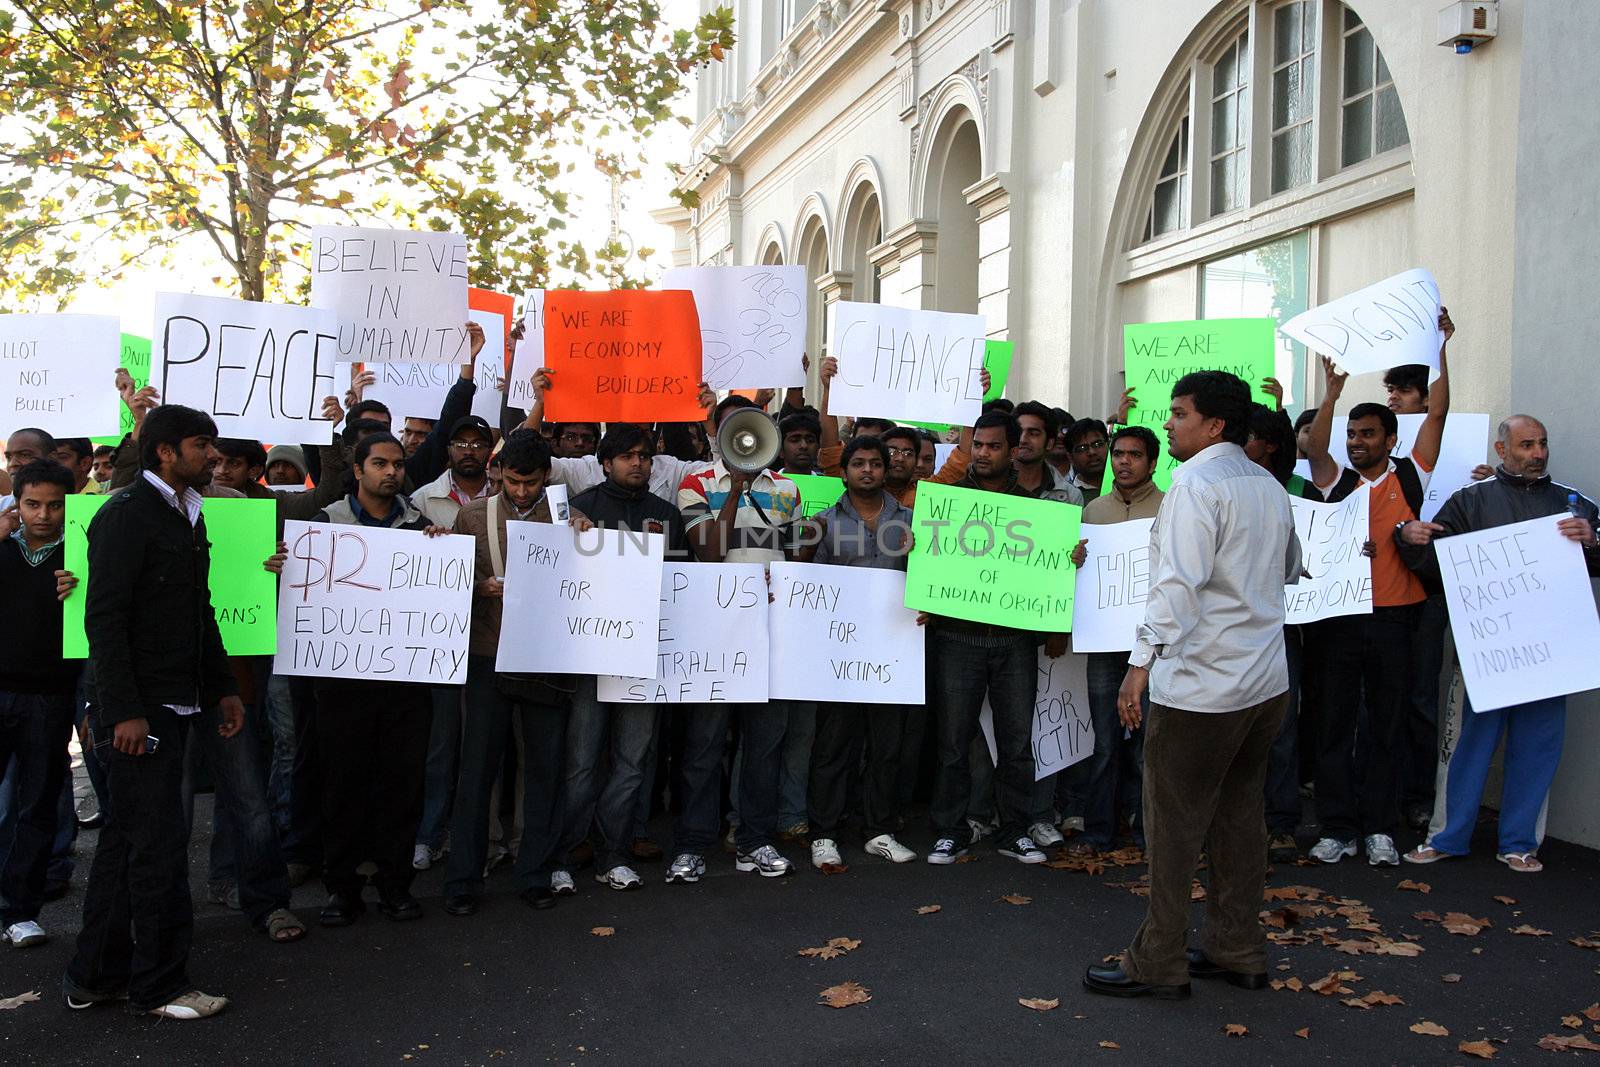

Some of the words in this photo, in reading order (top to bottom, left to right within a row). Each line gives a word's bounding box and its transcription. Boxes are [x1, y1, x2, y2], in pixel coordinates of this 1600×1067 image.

[318, 237, 468, 279] BELIEVE
[366, 285, 401, 320] IN
[600, 310, 632, 327] ARE
[1303, 280, 1438, 356] DIGNIT
[3, 340, 39, 359] LLOT
[338, 323, 470, 362] UMANITY
[569, 341, 663, 360] ECONOMY
[1131, 336, 1168, 358] WE
[1174, 334, 1220, 356] ARE
[20, 369, 49, 387] NOT
[161, 315, 338, 421] PEACE
[840, 320, 986, 405] CHANGE
[965, 502, 1008, 528] ARE
[289, 525, 383, 602] $12
[389, 551, 473, 591] BILLION
[926, 533, 1073, 571] AUSTRALIAN'S
[1448, 531, 1539, 582] HATE
[559, 579, 592, 600] FOR
[716, 573, 759, 609] US
[928, 584, 992, 604] INDIAN
[979, 569, 1001, 585] OF
[1458, 571, 1546, 613] RACISTS,
[1283, 576, 1373, 616] VERYONE
[294, 605, 469, 639] EDUCATION
[829, 620, 858, 643] FOR
[1469, 611, 1512, 641] NOT
[292, 638, 466, 681] INDUSTRY
[657, 650, 748, 680] TRALIA
[620, 681, 726, 702] SAFE
[1035, 690, 1078, 732] FOR
